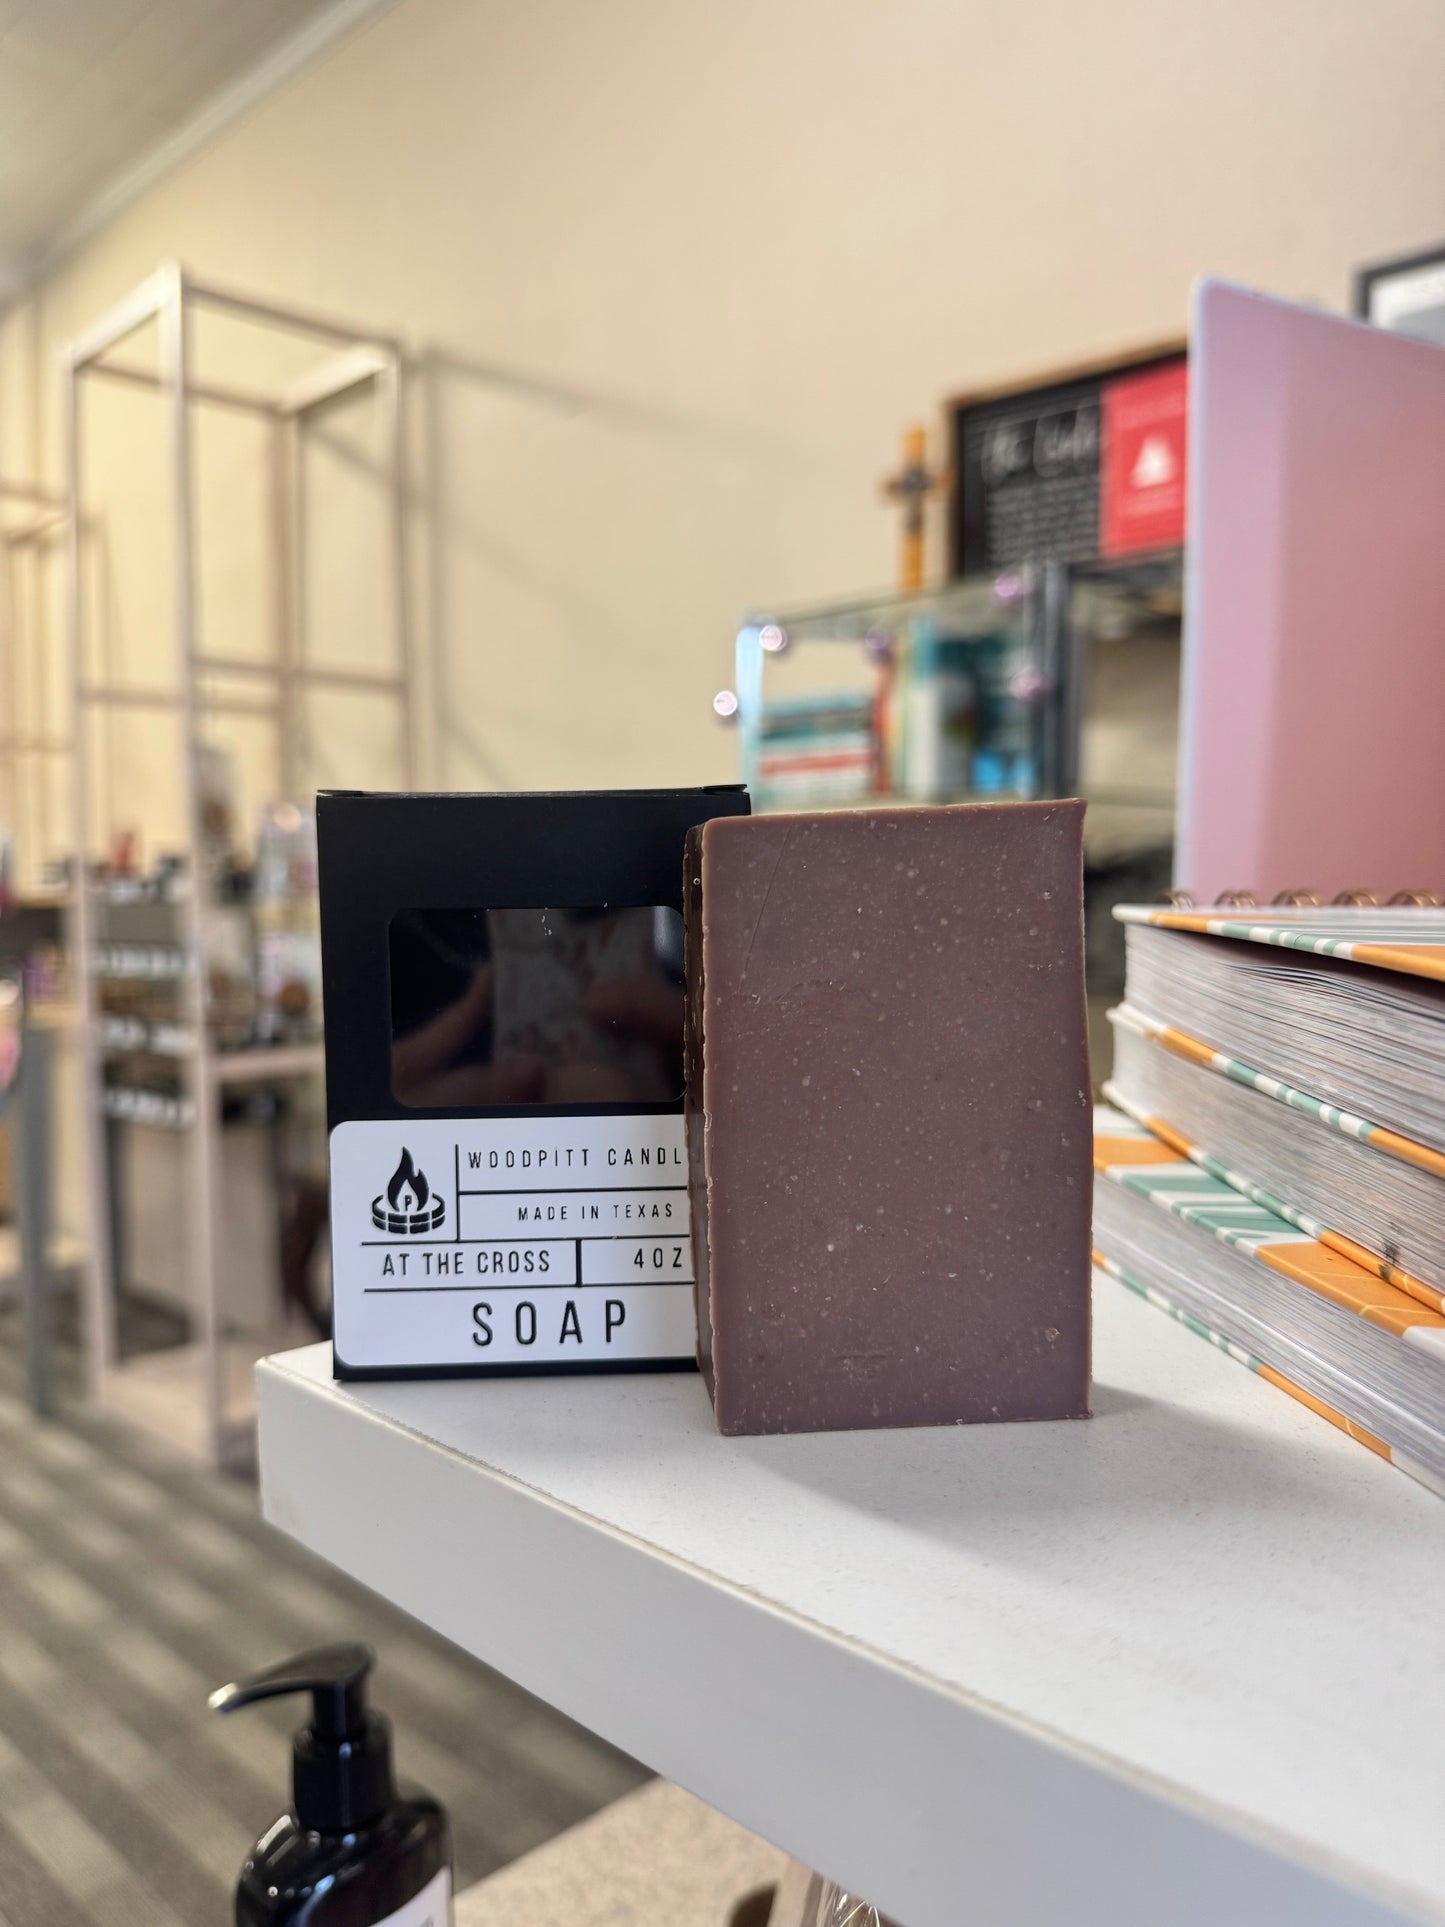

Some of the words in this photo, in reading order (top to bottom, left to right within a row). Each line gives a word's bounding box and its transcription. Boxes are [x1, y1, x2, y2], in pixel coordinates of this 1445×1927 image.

[467, 1149, 590, 1168] WOODPITT
[607, 1147, 682, 1166] CANDL
[518, 1206, 569, 1221] MADE
[581, 1205, 599, 1219] IN
[613, 1202, 673, 1218] TEXAS
[383, 1254, 411, 1276] AT
[423, 1252, 464, 1275] THE
[477, 1250, 551, 1273] CROSS
[472, 1300, 626, 1346] SOAP
